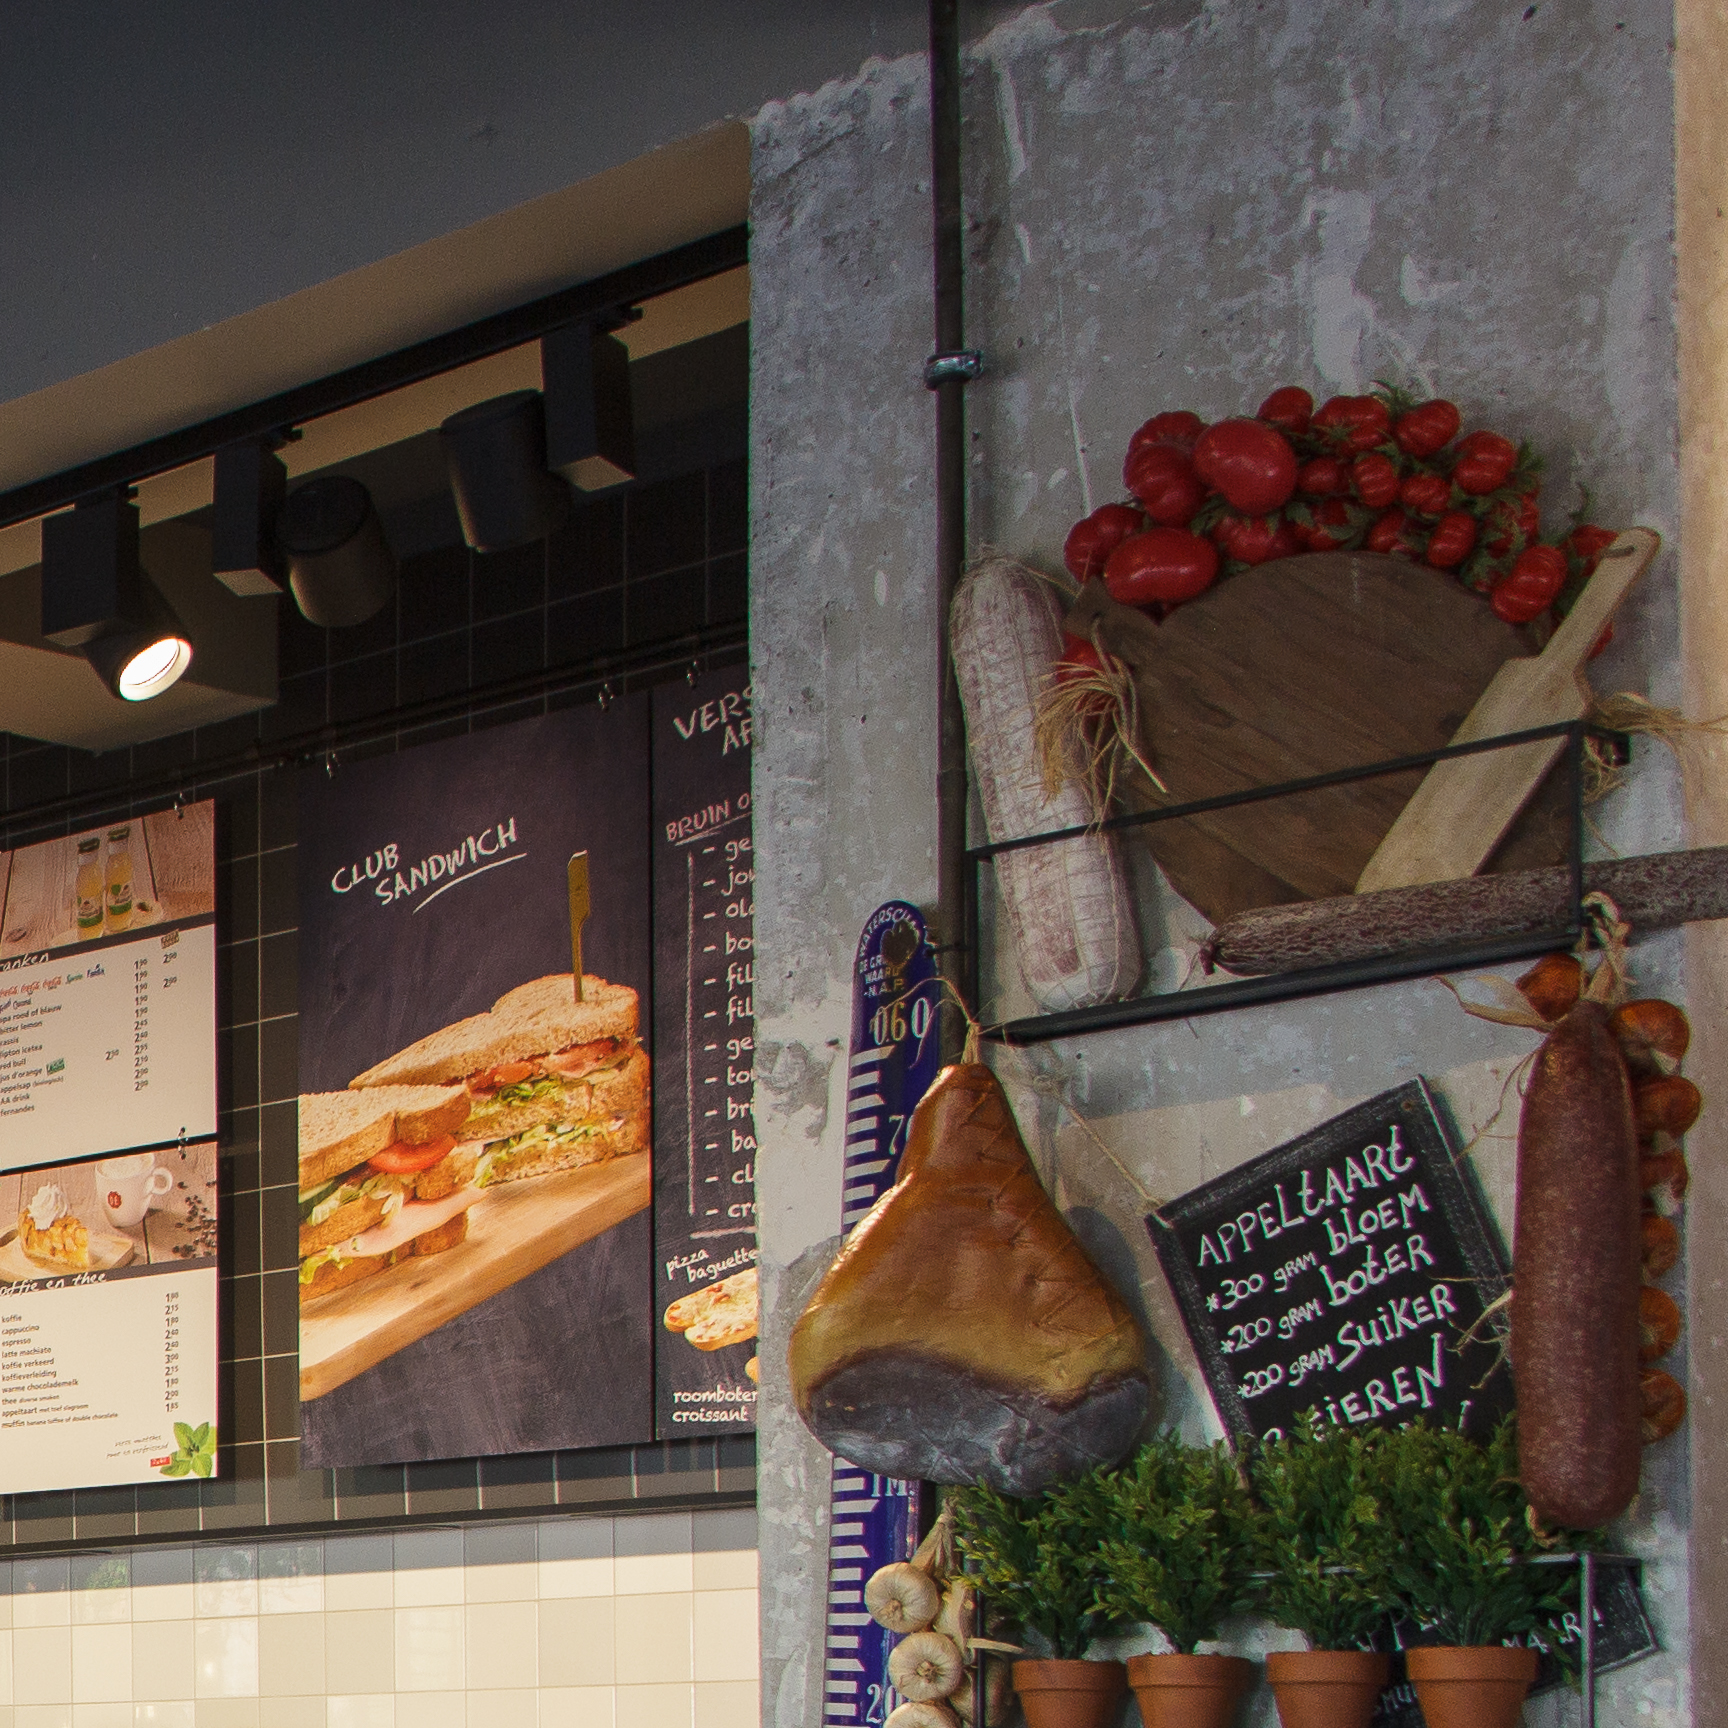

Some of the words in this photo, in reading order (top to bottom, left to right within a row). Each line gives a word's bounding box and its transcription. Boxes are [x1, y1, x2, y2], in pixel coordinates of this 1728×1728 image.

[666, 800, 730, 842] BRUIN
[331, 843, 399, 893] CLUB
[375, 816, 517, 906] SANDWICH
[666, 1248, 709, 1281] pizza
[46, 1279, 65, 1291] en
[73, 1271, 107, 1286] thee
[2, 1314, 22, 1323] koffie
[2, 1325, 40, 1336] cappuccino
[2, 1338, 31, 1347] espresso
[2, 1361, 22, 1370] koffie
[25, 1358, 55, 1368] verkeerd
[2, 1370, 57, 1382] koffieverleiding
[672, 1406, 748, 1423] croissant
